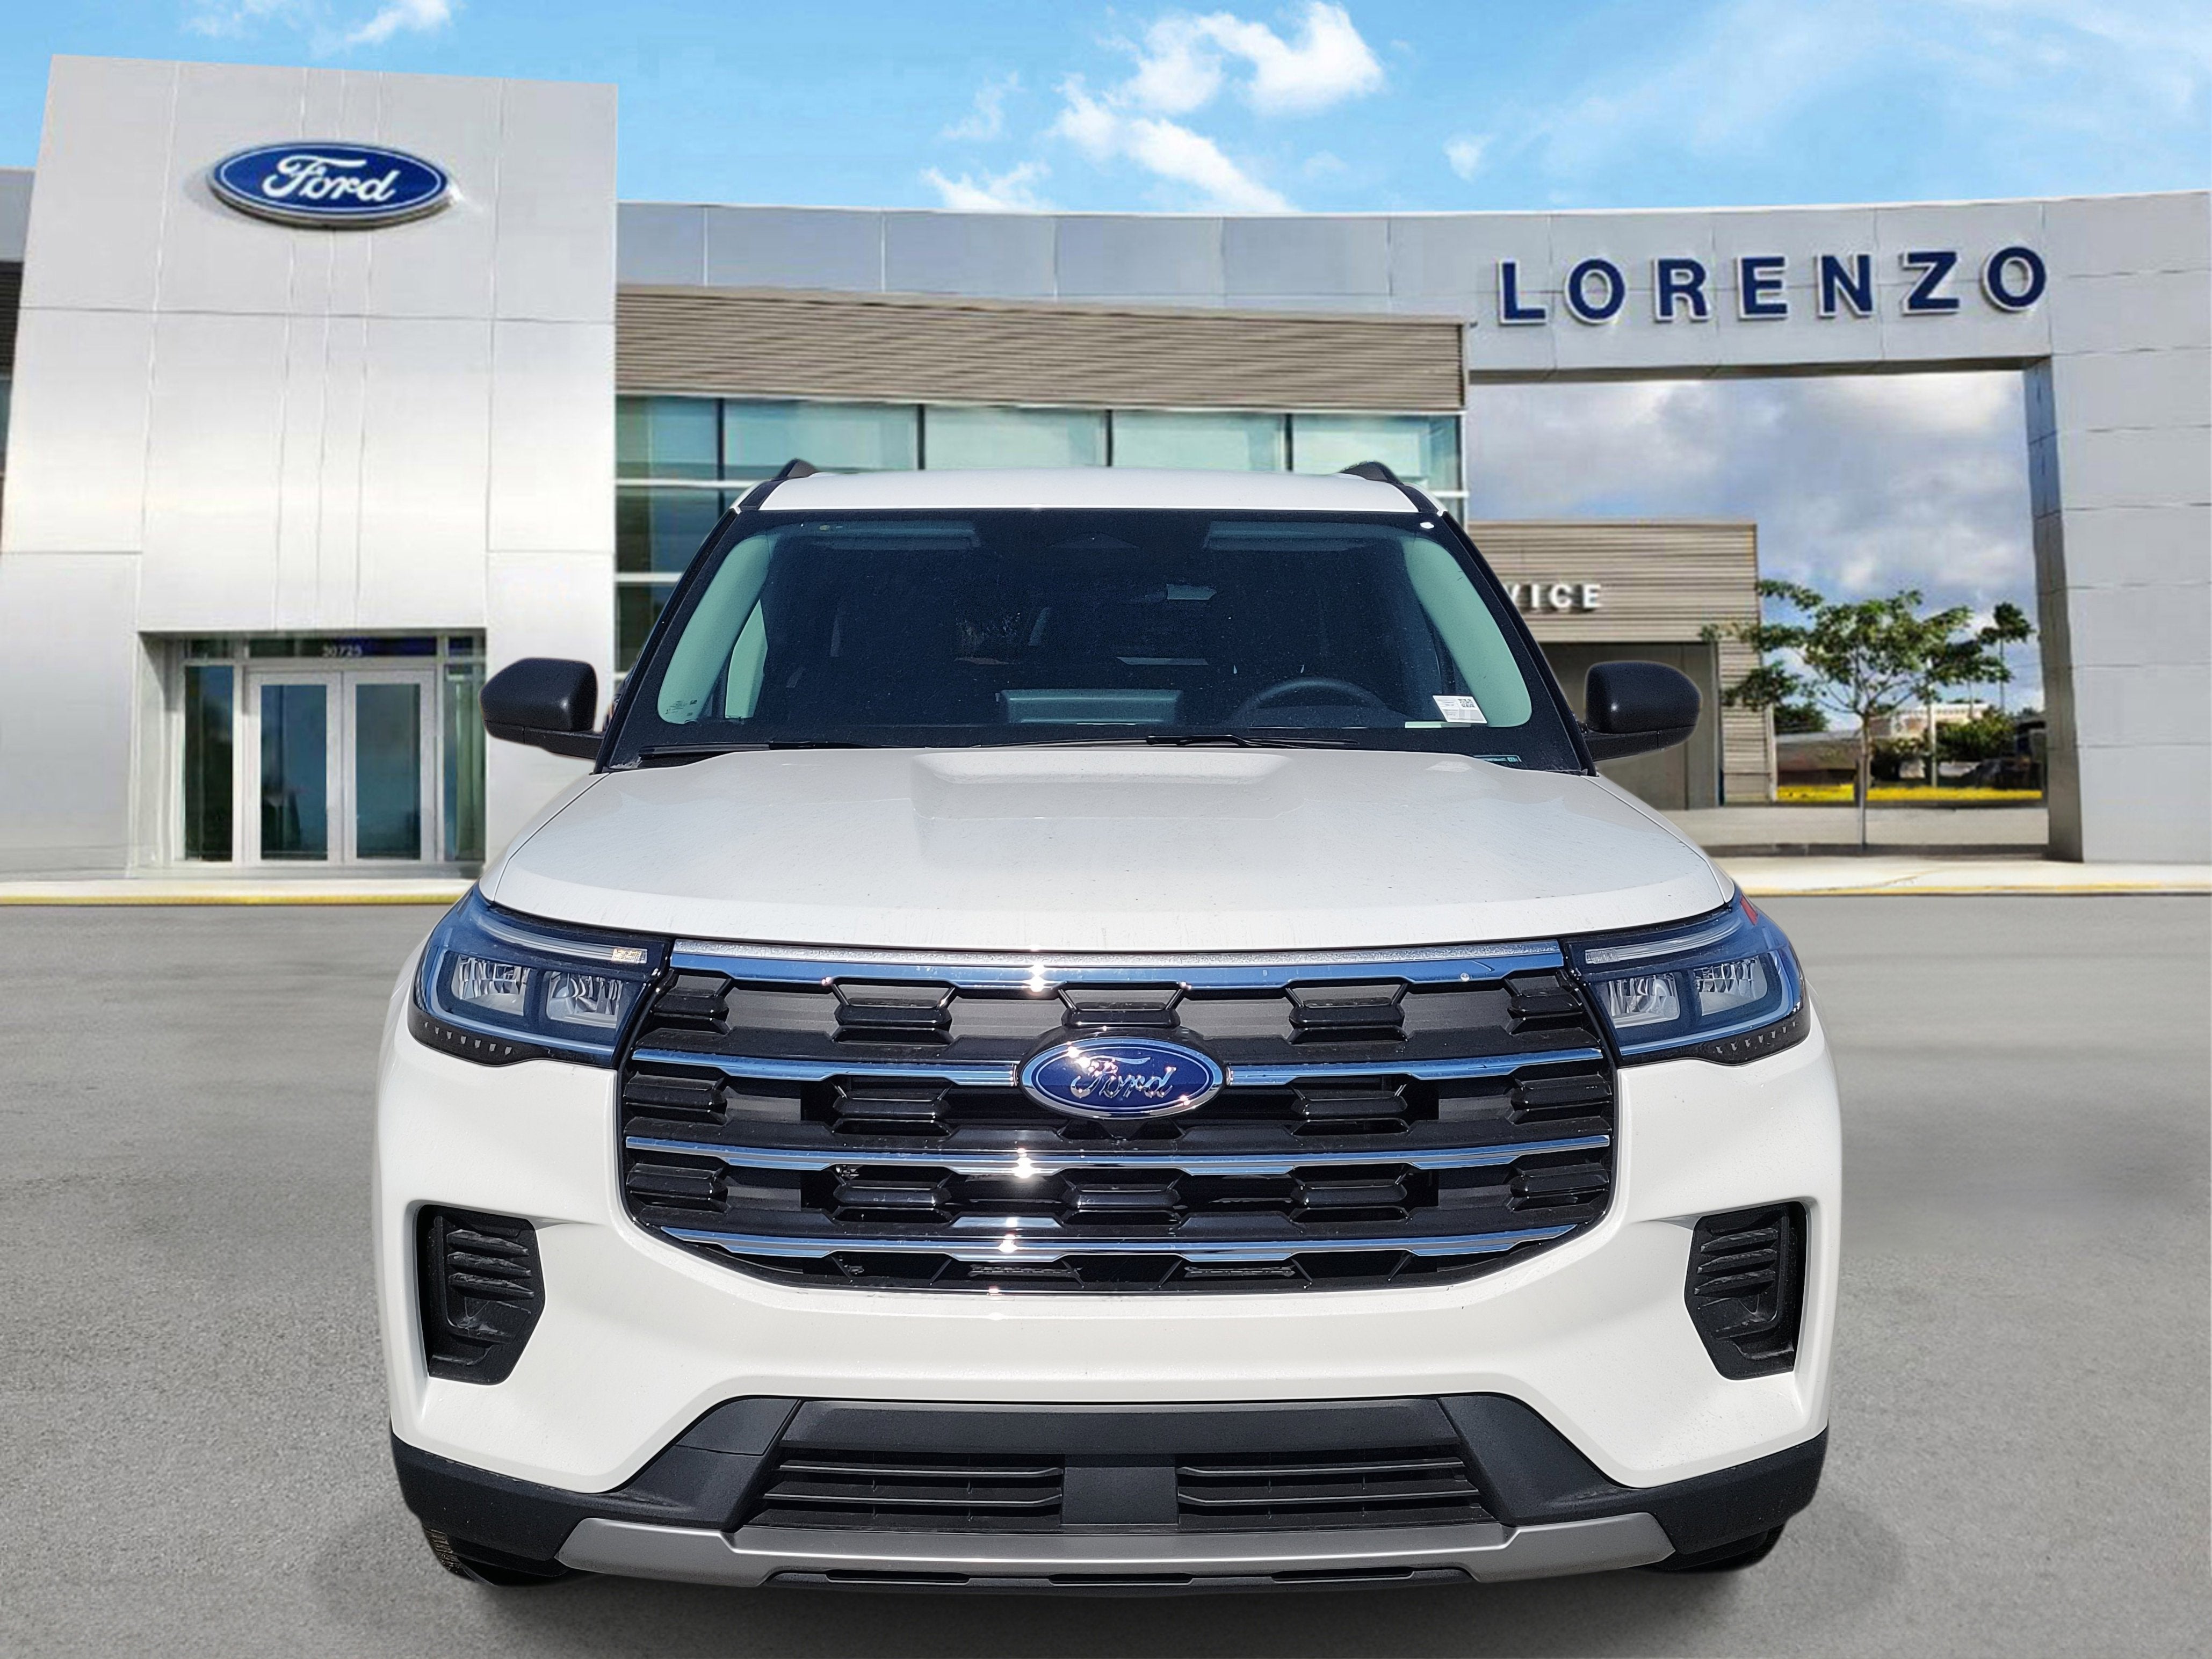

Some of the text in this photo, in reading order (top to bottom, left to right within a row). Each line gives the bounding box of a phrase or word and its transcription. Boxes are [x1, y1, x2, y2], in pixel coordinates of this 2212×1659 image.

[262, 155, 400, 201] Ford
[1500, 247, 2047, 322] LORENZO
[1071, 1055, 1176, 1098] Ford
